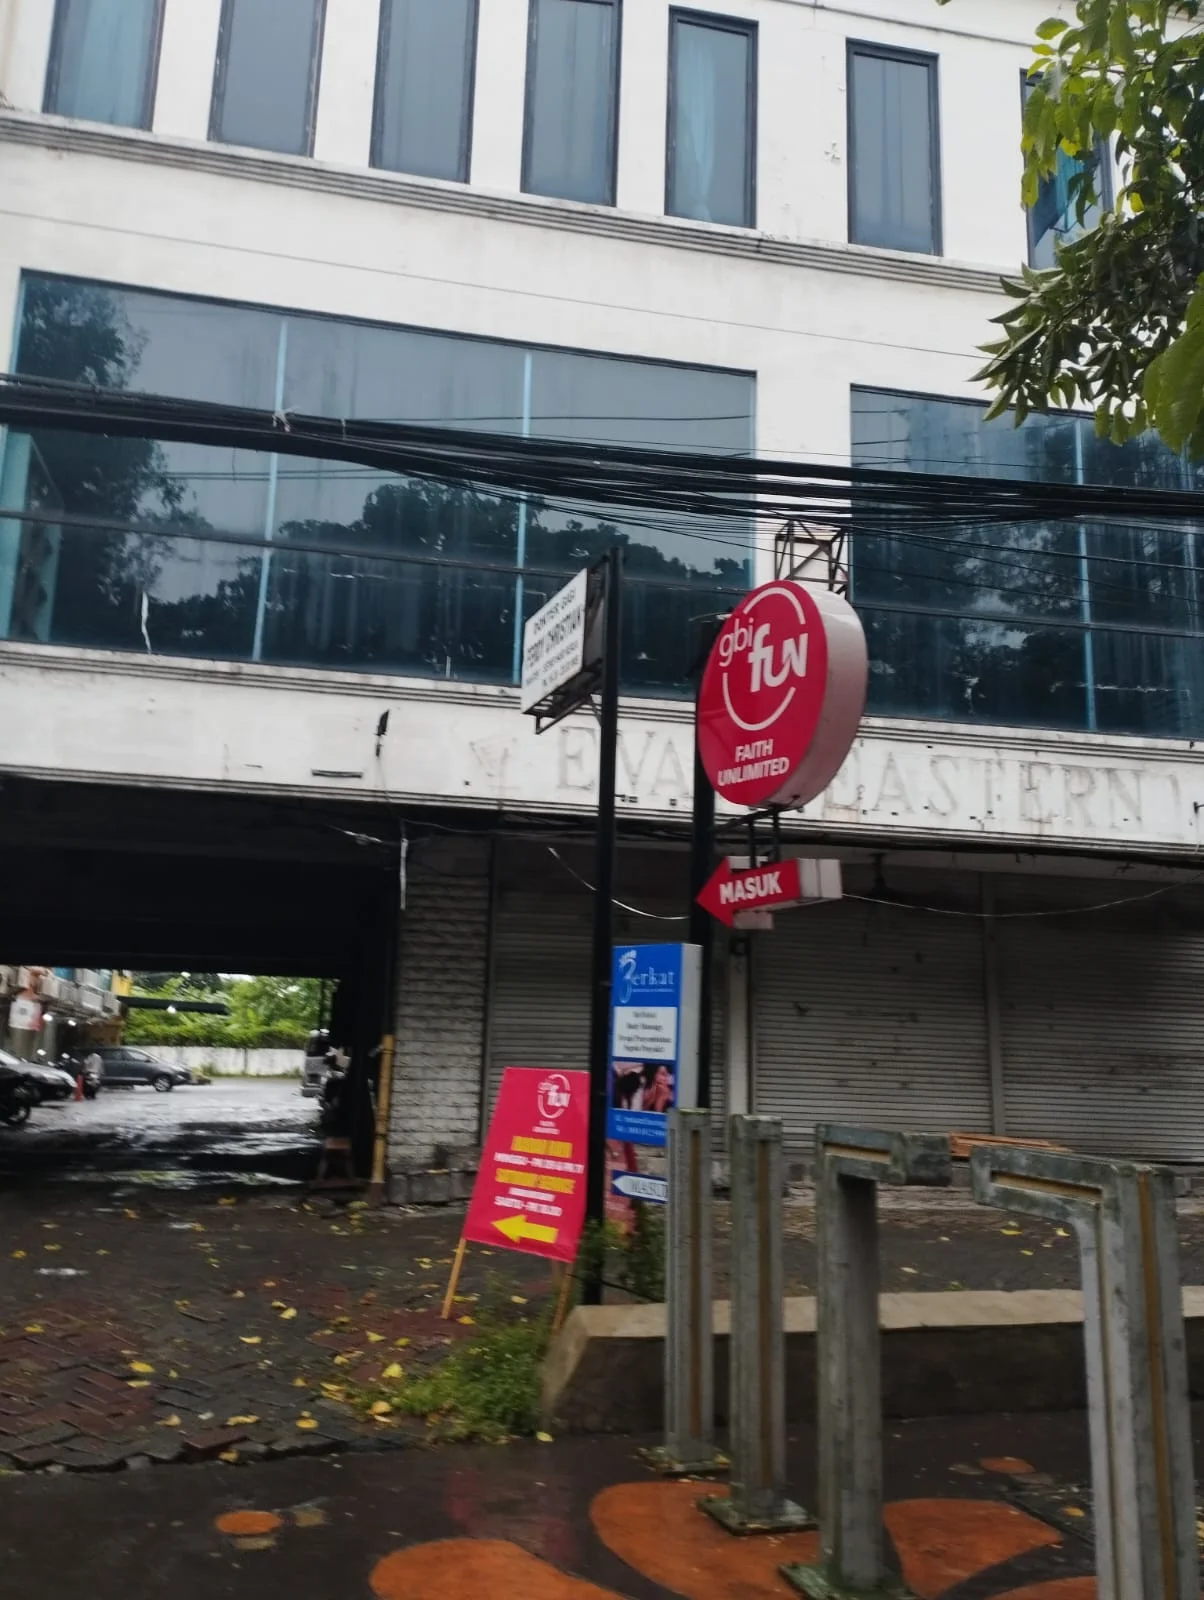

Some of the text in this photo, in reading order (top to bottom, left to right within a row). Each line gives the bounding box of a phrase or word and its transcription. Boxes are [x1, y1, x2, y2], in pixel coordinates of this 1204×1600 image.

[719, 617, 754, 667] gbi
[735, 739, 774, 763] FAITH
[717, 757, 790, 786] UNLIMITED
[719, 871, 782, 904] MASUK
[631, 1180, 668, 1197] MASU
